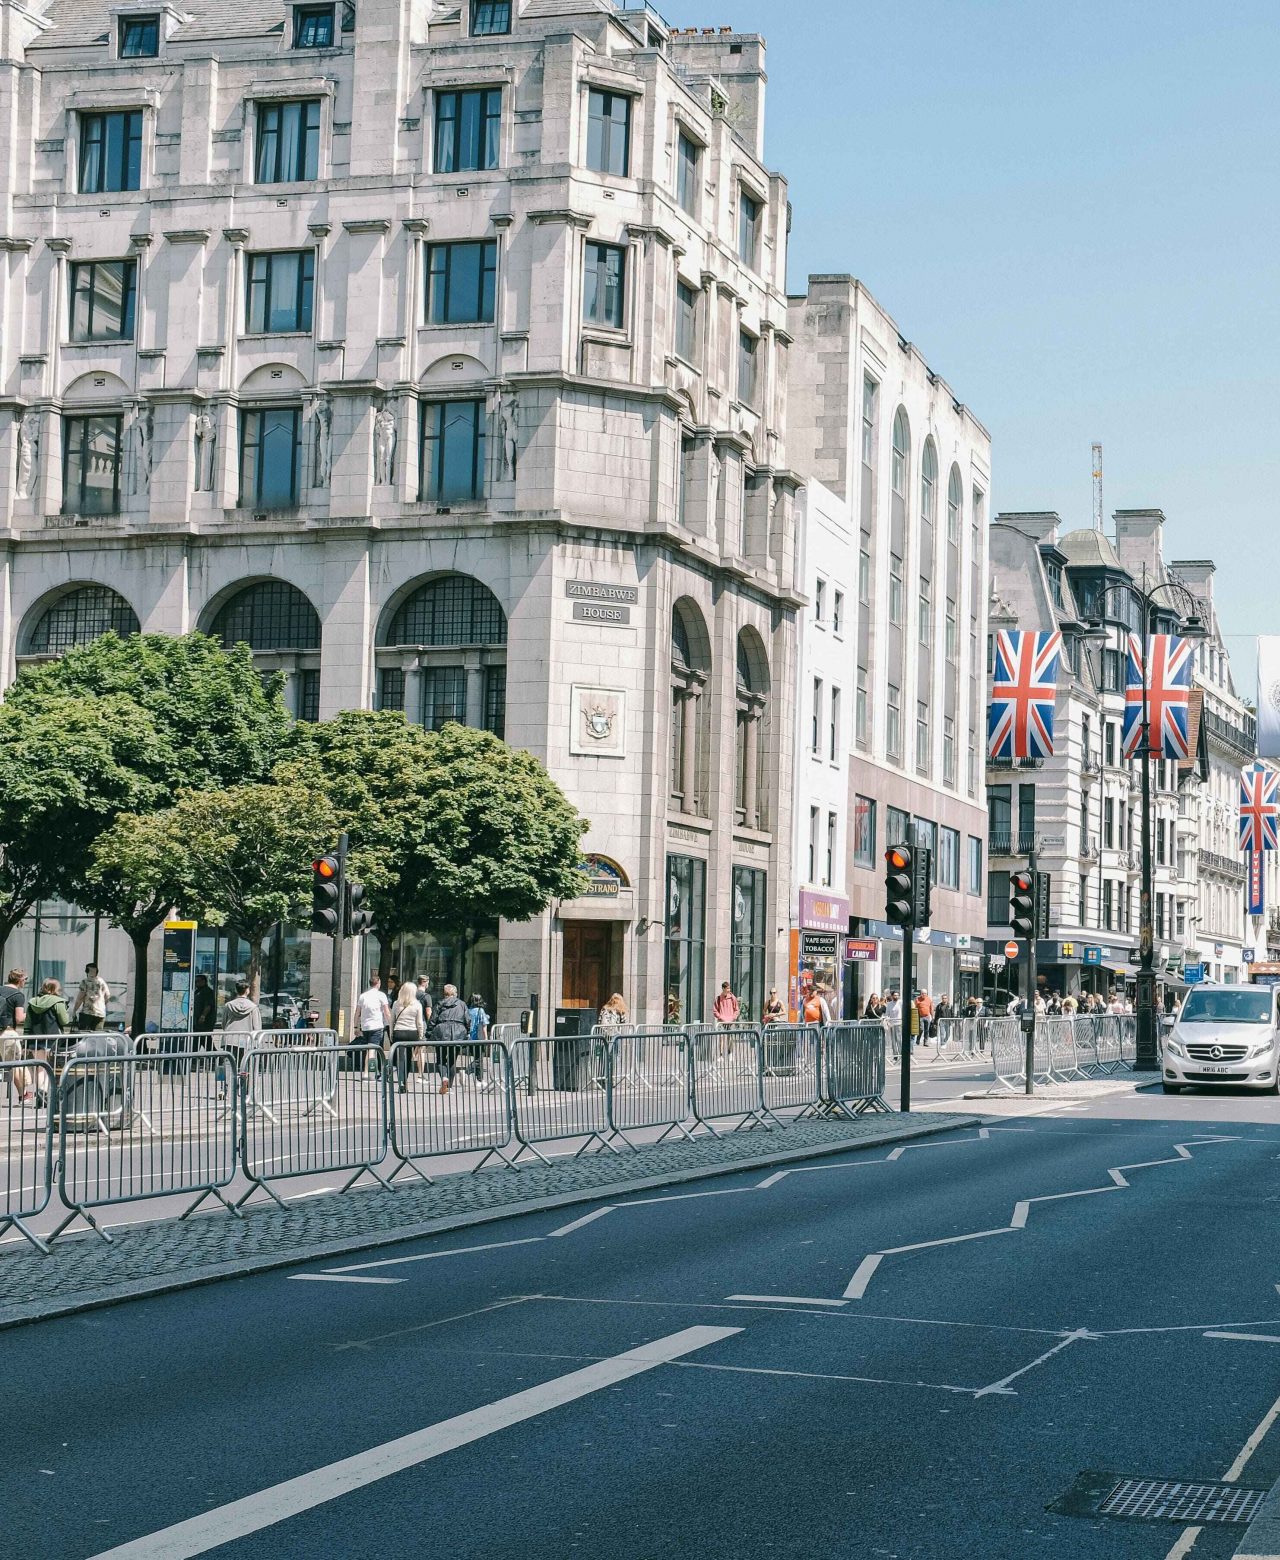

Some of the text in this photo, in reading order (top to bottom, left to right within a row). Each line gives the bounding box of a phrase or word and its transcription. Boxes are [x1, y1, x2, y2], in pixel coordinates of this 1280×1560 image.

[569, 584, 636, 600] ZIMBABWE
[582, 607, 622, 620] HOUSE
[589, 884, 618, 893] STRAND
[805, 945, 835, 953] TOBACCO
